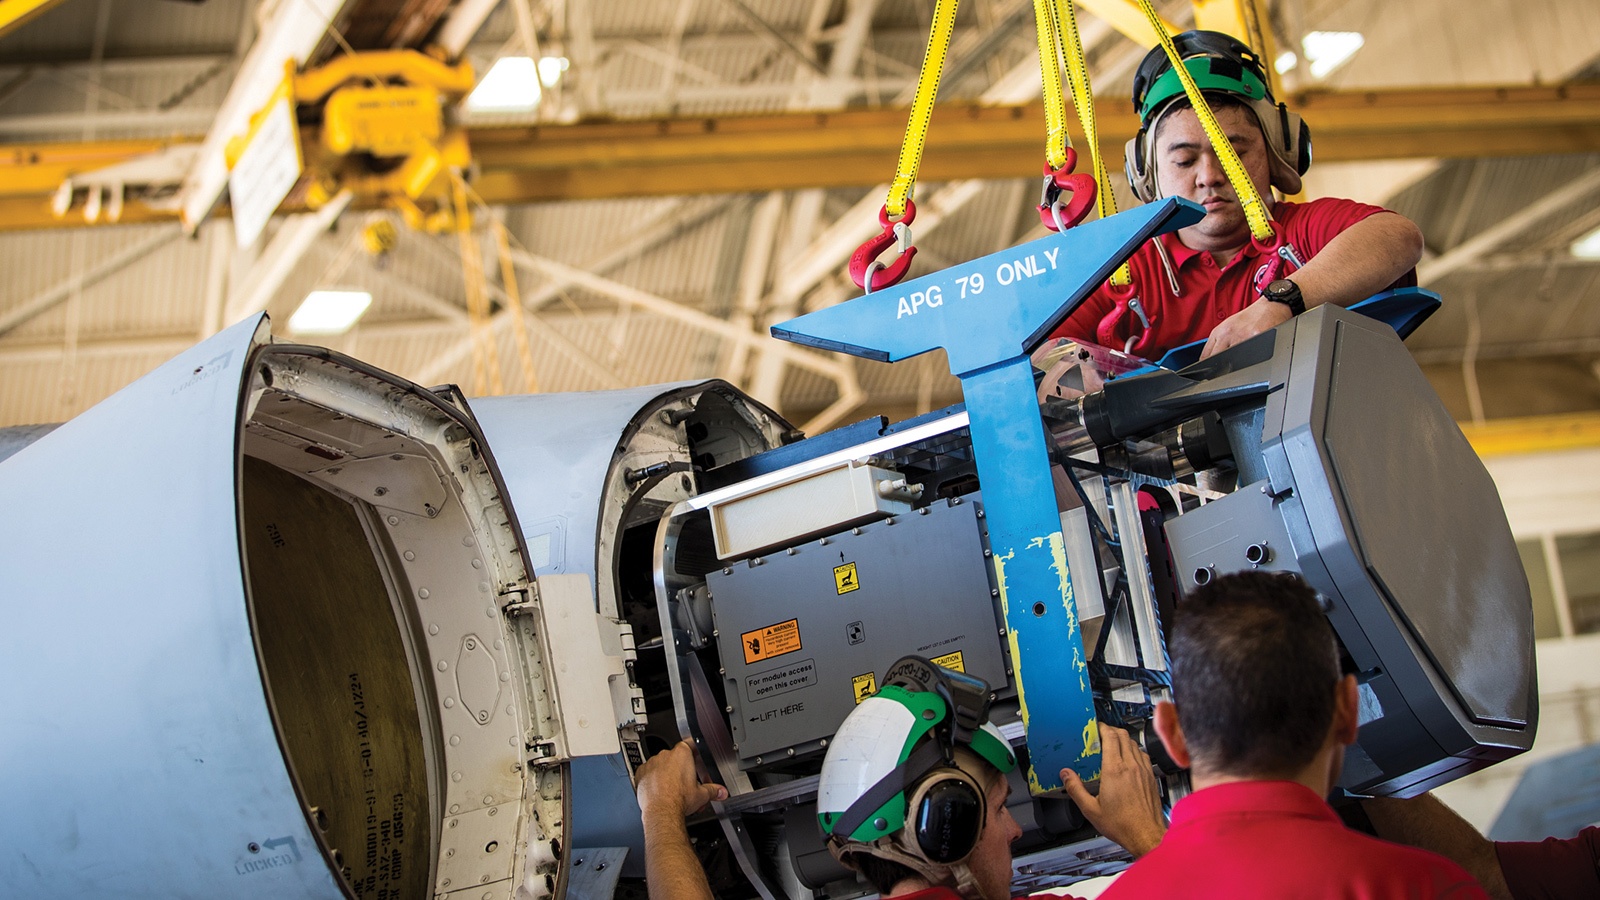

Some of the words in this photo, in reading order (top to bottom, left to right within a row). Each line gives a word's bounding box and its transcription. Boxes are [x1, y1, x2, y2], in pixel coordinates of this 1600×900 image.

[896, 285, 944, 320] APG
[955, 272, 985, 299] 79
[996, 247, 1060, 286] ONLY
[772, 622, 795, 633] WARNING
[937, 654, 960, 666] CAUTION
[748, 679, 761, 687] For
[762, 671, 787, 684] module
[788, 664, 813, 676] access
[756, 684, 774, 695] open
[774, 680, 788, 691] this
[789, 675, 809, 686] cover
[760, 709, 778, 722] LIFT
[780, 702, 805, 717] HERE
[234, 854, 292, 875] LOCKED
[391, 848, 402, 881] CORP
